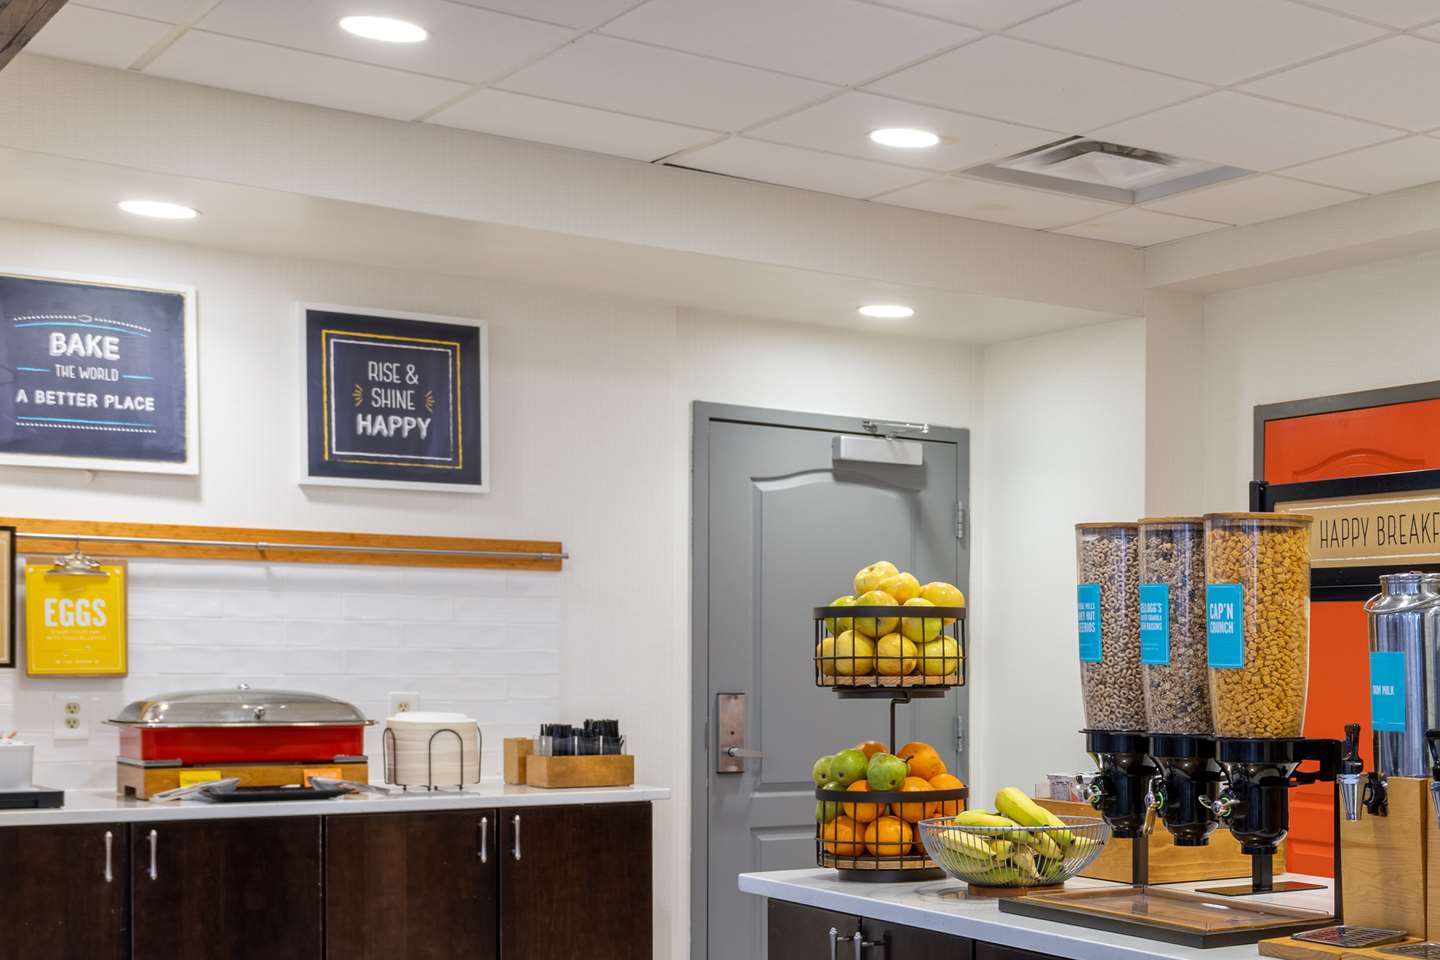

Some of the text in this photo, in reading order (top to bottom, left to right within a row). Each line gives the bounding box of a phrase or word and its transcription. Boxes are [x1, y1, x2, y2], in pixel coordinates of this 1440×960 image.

[49, 331, 121, 361] BAKE
[54, 364, 119, 382] THE WORLD
[368, 360, 419, 385] RISE &
[16, 388, 156, 412] A BETTER PLACE
[371, 387, 416, 411] SHINE
[356, 412, 432, 440] HAPPY
[1319, 516, 1370, 549] HAPPY
[44, 597, 107, 627] EGGS
[1209, 602, 1234, 620] CAP'N
[1210, 620, 1234, 634] CRUNCH
[1382, 685, 1395, 696] MILK
